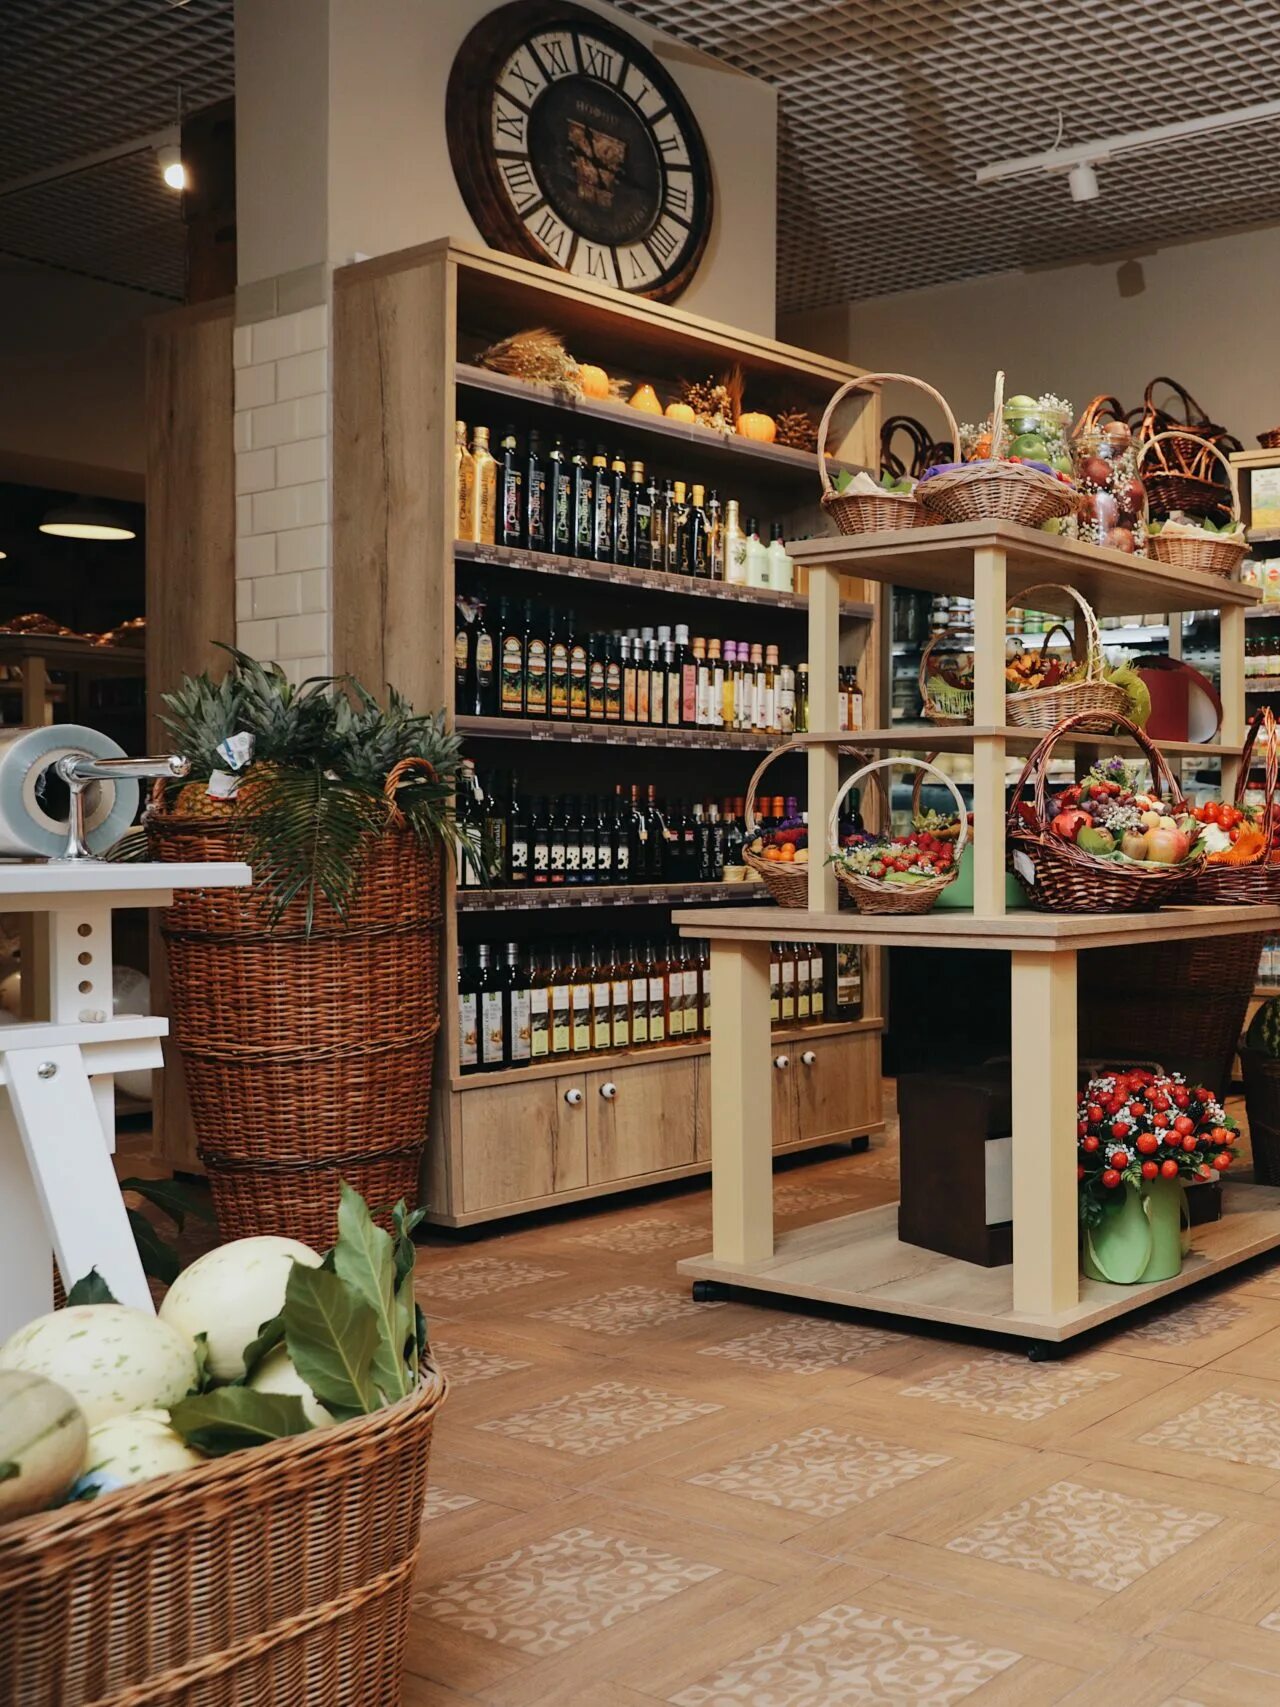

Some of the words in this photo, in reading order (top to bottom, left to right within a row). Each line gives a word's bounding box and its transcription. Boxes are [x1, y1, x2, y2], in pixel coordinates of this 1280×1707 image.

[541, 41, 572, 76] XI
[586, 44, 613, 82] XII
[511, 62, 539, 97] X
[634, 87, 650, 103] I
[496, 108, 524, 144] IX
[658, 134, 680, 153] II
[501, 164, 537, 210] VIII
[666, 187, 688, 211] III
[536, 213, 565, 256] VII
[655, 222, 679, 260] IIII
[586, 245, 610, 279] VI
[628, 251, 646, 279] V
